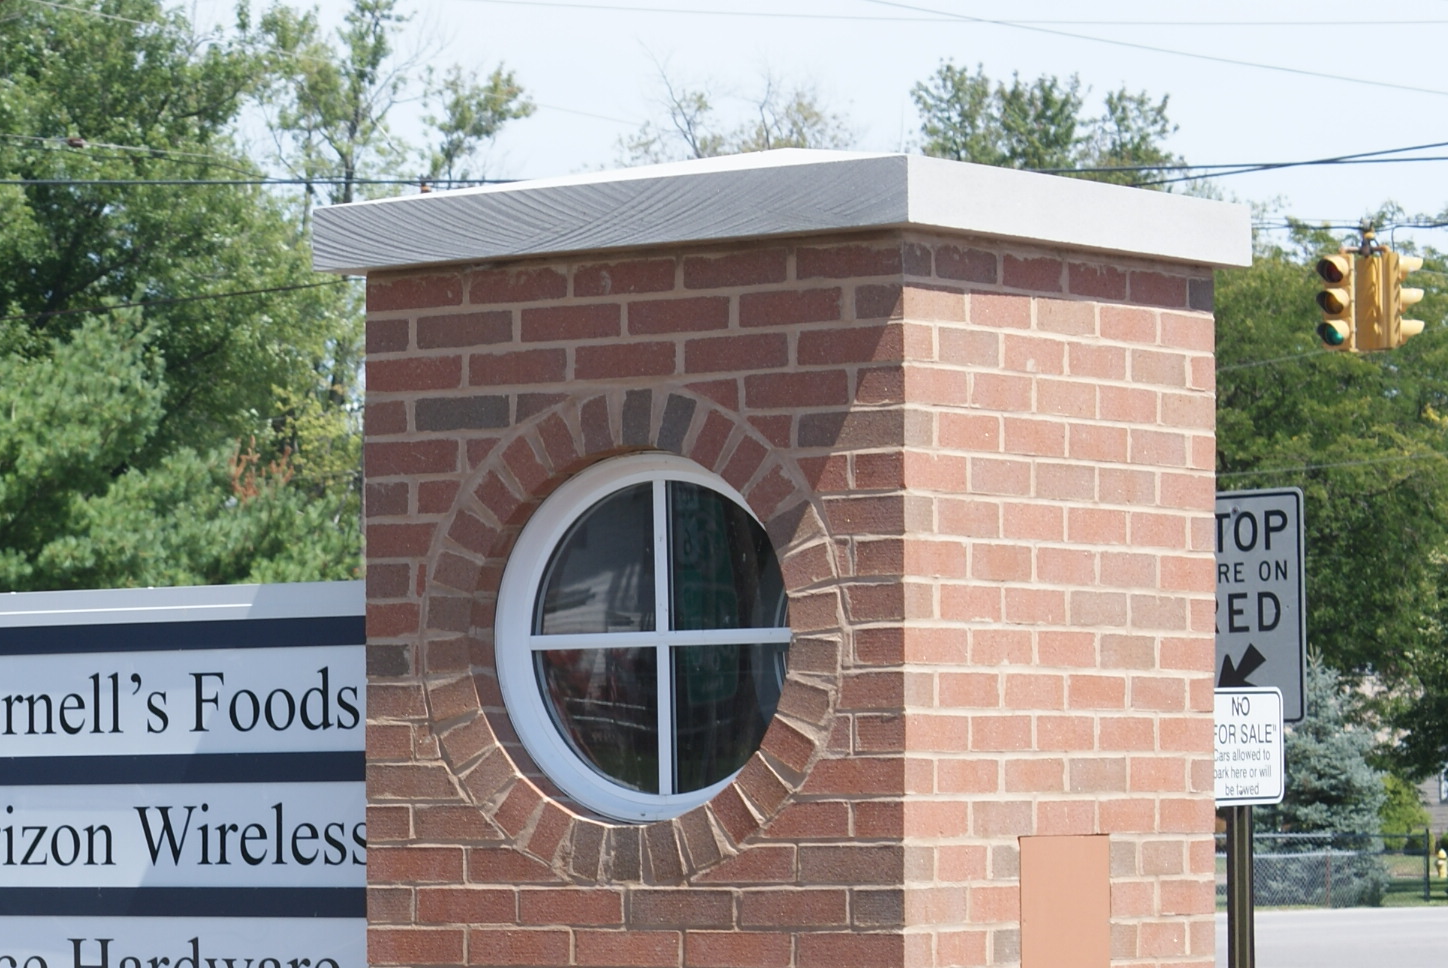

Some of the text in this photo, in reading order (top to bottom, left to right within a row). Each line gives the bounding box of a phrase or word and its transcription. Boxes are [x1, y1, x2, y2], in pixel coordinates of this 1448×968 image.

[1215, 509, 1288, 553] TOP
[1217, 560, 1288, 584] RE ON
[1215, 591, 1282, 634] ED
[188, 665, 361, 733] Foods
[1231, 696, 1251, 717] NO
[1232, 747, 1261, 761] allowed
[1262, 748, 1271, 761] to
[1230, 765, 1248, 778] here
[1249, 768, 1258, 778] or
[1259, 764, 1272, 778] will
[1224, 781, 1260, 796] be towed
[133, 801, 365, 867] Wireless
